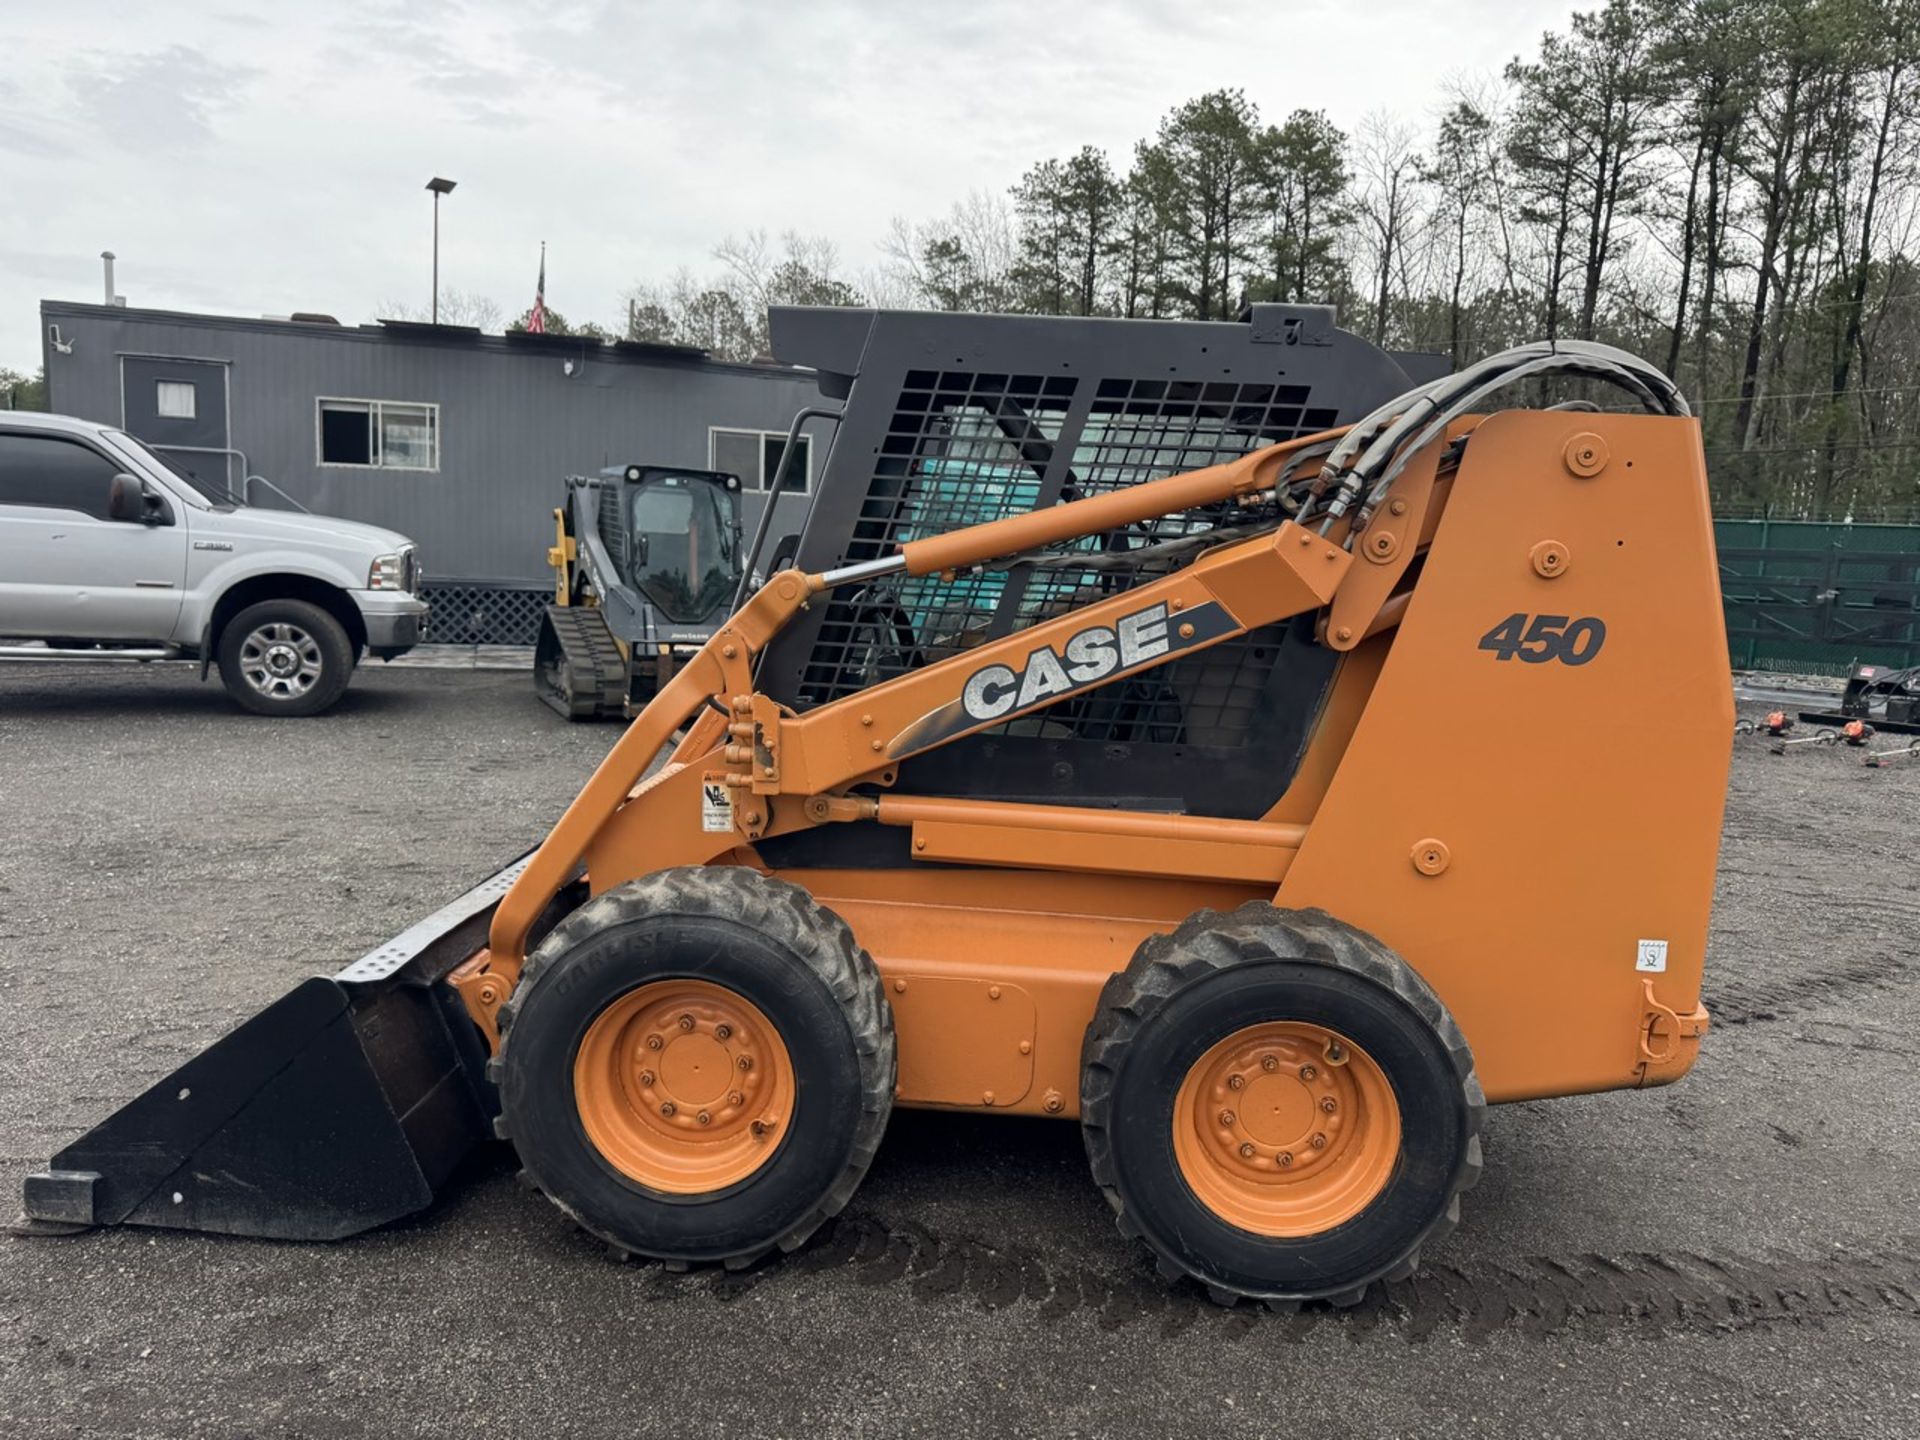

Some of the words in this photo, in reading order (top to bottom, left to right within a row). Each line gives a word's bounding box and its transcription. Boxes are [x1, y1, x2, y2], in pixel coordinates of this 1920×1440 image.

[962, 602, 1170, 720] CASE
[1477, 612, 1606, 666] 450
[554, 930, 693, 997] CARLISLE
